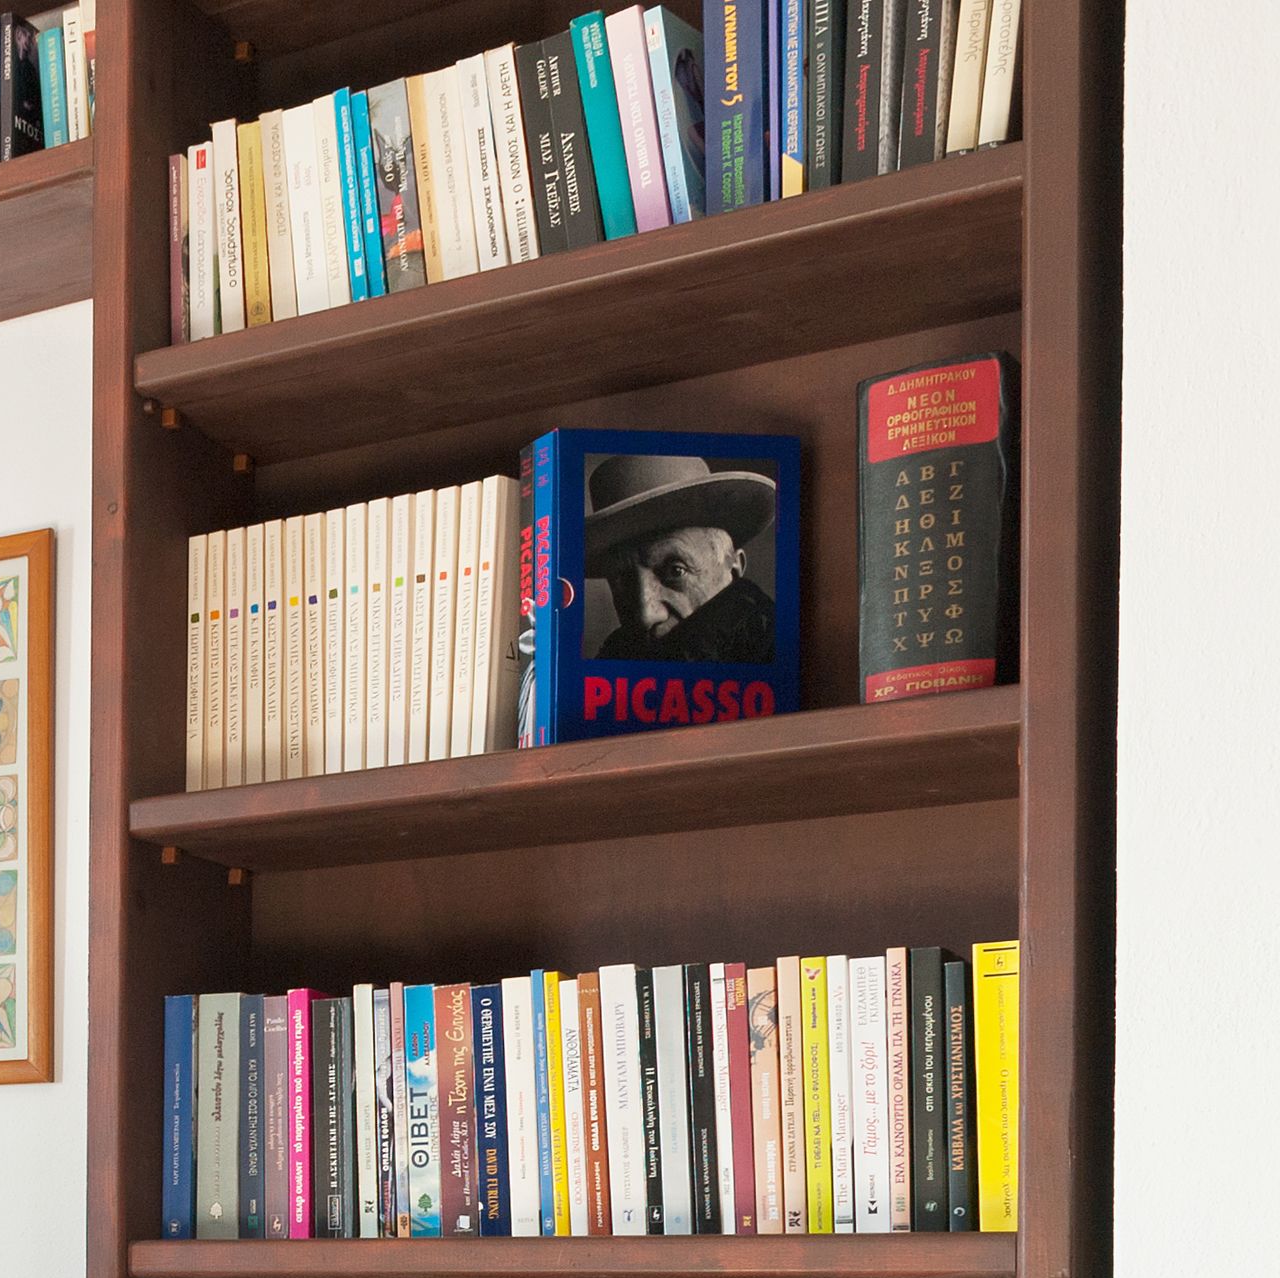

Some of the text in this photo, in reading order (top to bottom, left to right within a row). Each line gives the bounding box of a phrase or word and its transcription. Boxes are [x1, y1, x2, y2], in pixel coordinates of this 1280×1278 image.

[724, 5, 738, 63] ΔΥΝΑΜΗ
[499, 61, 513, 98] ΑΡΕΤΗ
[725, 64, 738, 91] ΤΟΥ
[505, 114, 517, 133] ΚΑΙ
[815, 53, 827, 170] ΟΛΥΜΠΙΑΚΟΙ ΑΓΩΝΕΣ
[508, 136, 522, 180] ΝΟΜΟΣ
[539, 132, 552, 165] ΜΙΑΣ
[907, 389, 956, 410] ΝΕΟΝ
[886, 401, 977, 427] ΟΡΘΟΓΡΑΦΙΚΟΝ
[887, 414, 977, 441] ΕΡΜΗΝΕΥΤΙΚΟΝ
[902, 431, 957, 451] ΛΕΞΙΚΟΝ
[895, 461, 964, 487] Α Β Γ
[895, 484, 964, 510] Δ Ε Ζ
[894, 509, 962, 536] Η Θ Ι
[894, 531, 965, 558] Κ Λ Μ
[520, 525, 533, 616] PICASSO
[536, 514, 551, 607] PICASSO
[893, 555, 963, 581] Ν Ξ Ο
[893, 579, 963, 605] Π Ρ Σ
[893, 603, 963, 628] Τ Υ Φ
[891, 628, 964, 653] Χ Ψ Ω
[905, 674, 986, 692] ΓΙΟΒΑΝΗ
[582, 675, 776, 724] PICASSO
[481, 1009, 493, 1064] ΘΕΡΑΠΕΥΤΗΣ
[922, 995, 935, 1112] στη σκιά του πεπρωμένου
[482, 1067, 494, 1093] ΕΙΝΑΙ
[891, 961, 905, 1184] ΕΝΑ ΚΑΙΝΟΥΡΓΙΟ ΟΡΑΜΑ ΓΙΑ ΤΗ ΓΥΝΑΙΚΑ
[950, 1005, 964, 1171] ΚΑΒΒΑΛΑ ΧΡΙΣΤΙΑΝΙΣΜΟΣ
[483, 1095, 495, 1119] ΜΕΣΑ
[409, 1087, 429, 1169] ΘΙΒΕΤ
[484, 1122, 496, 1139] ΣΟΥ
[835, 1092, 849, 1206] The Mafia Manager
